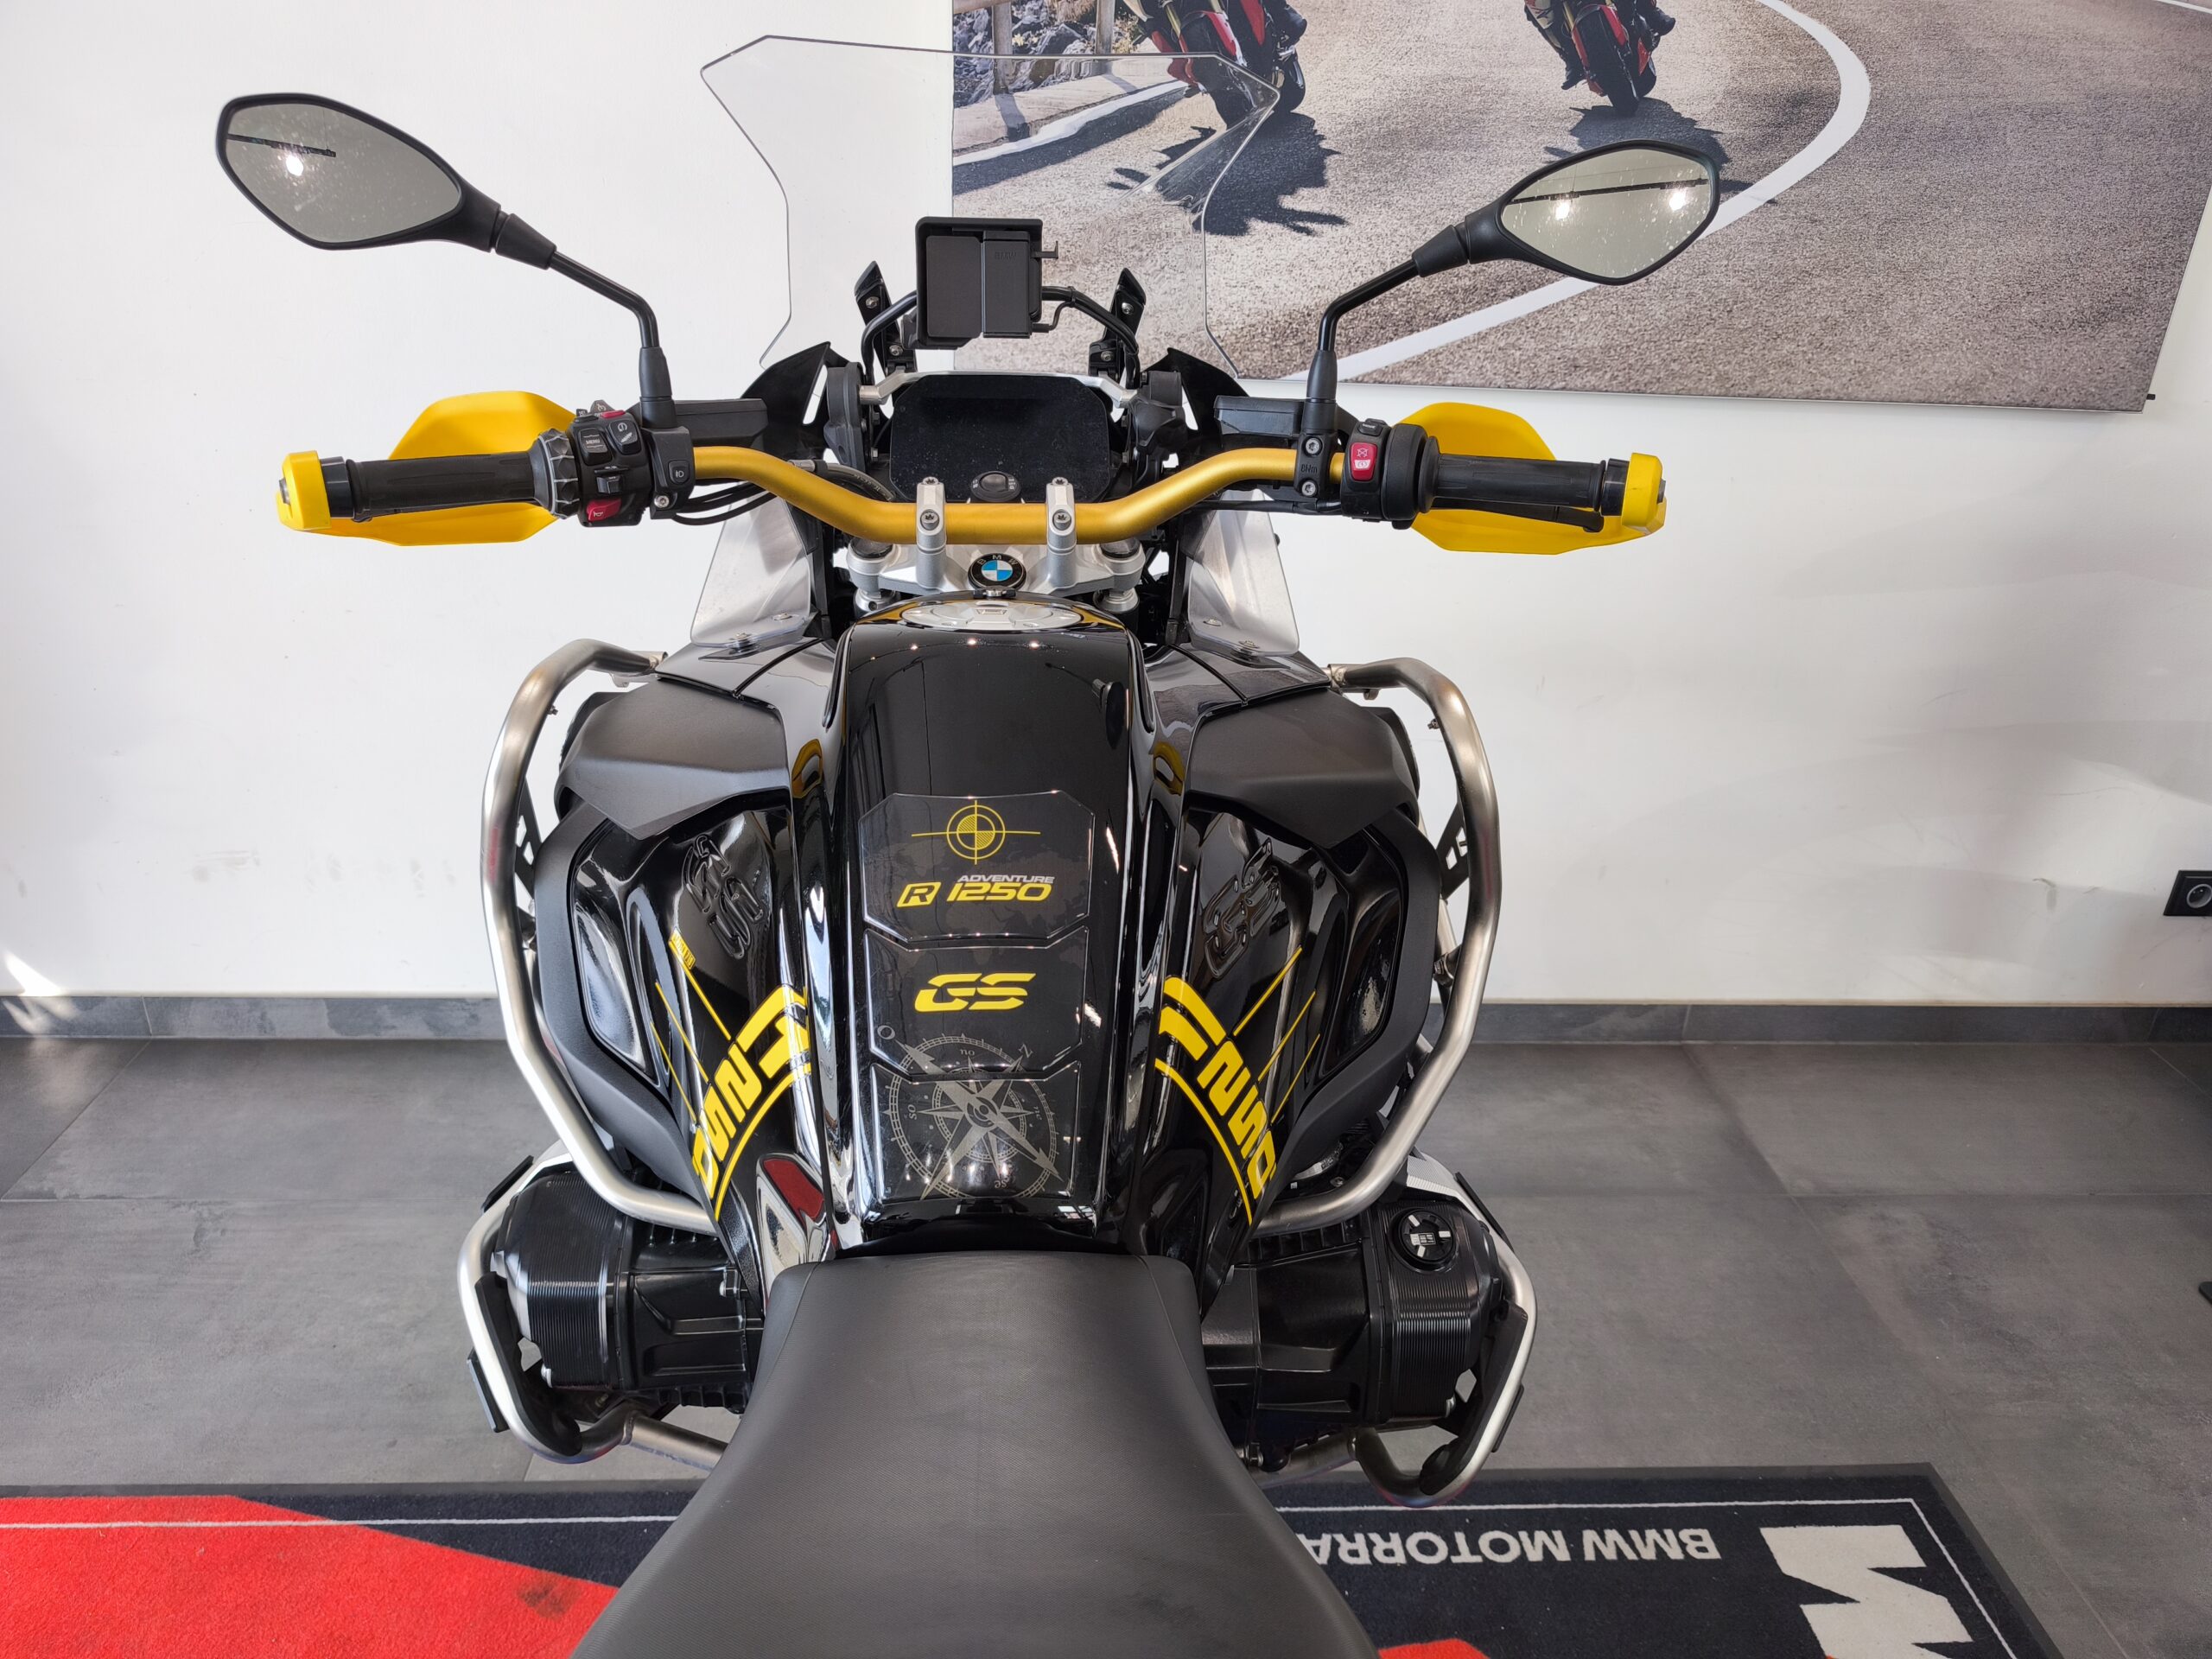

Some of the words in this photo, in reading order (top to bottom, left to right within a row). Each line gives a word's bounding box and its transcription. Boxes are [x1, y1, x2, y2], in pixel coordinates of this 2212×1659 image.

[977, 554, 1018, 566] BMW
[957, 874, 1056, 884] ADVENTURE
[900, 883, 938, 906] R
[946, 881, 1053, 902] 1250
[914, 972, 1037, 1013] GS
[1582, 1528, 1722, 1560] BMW
